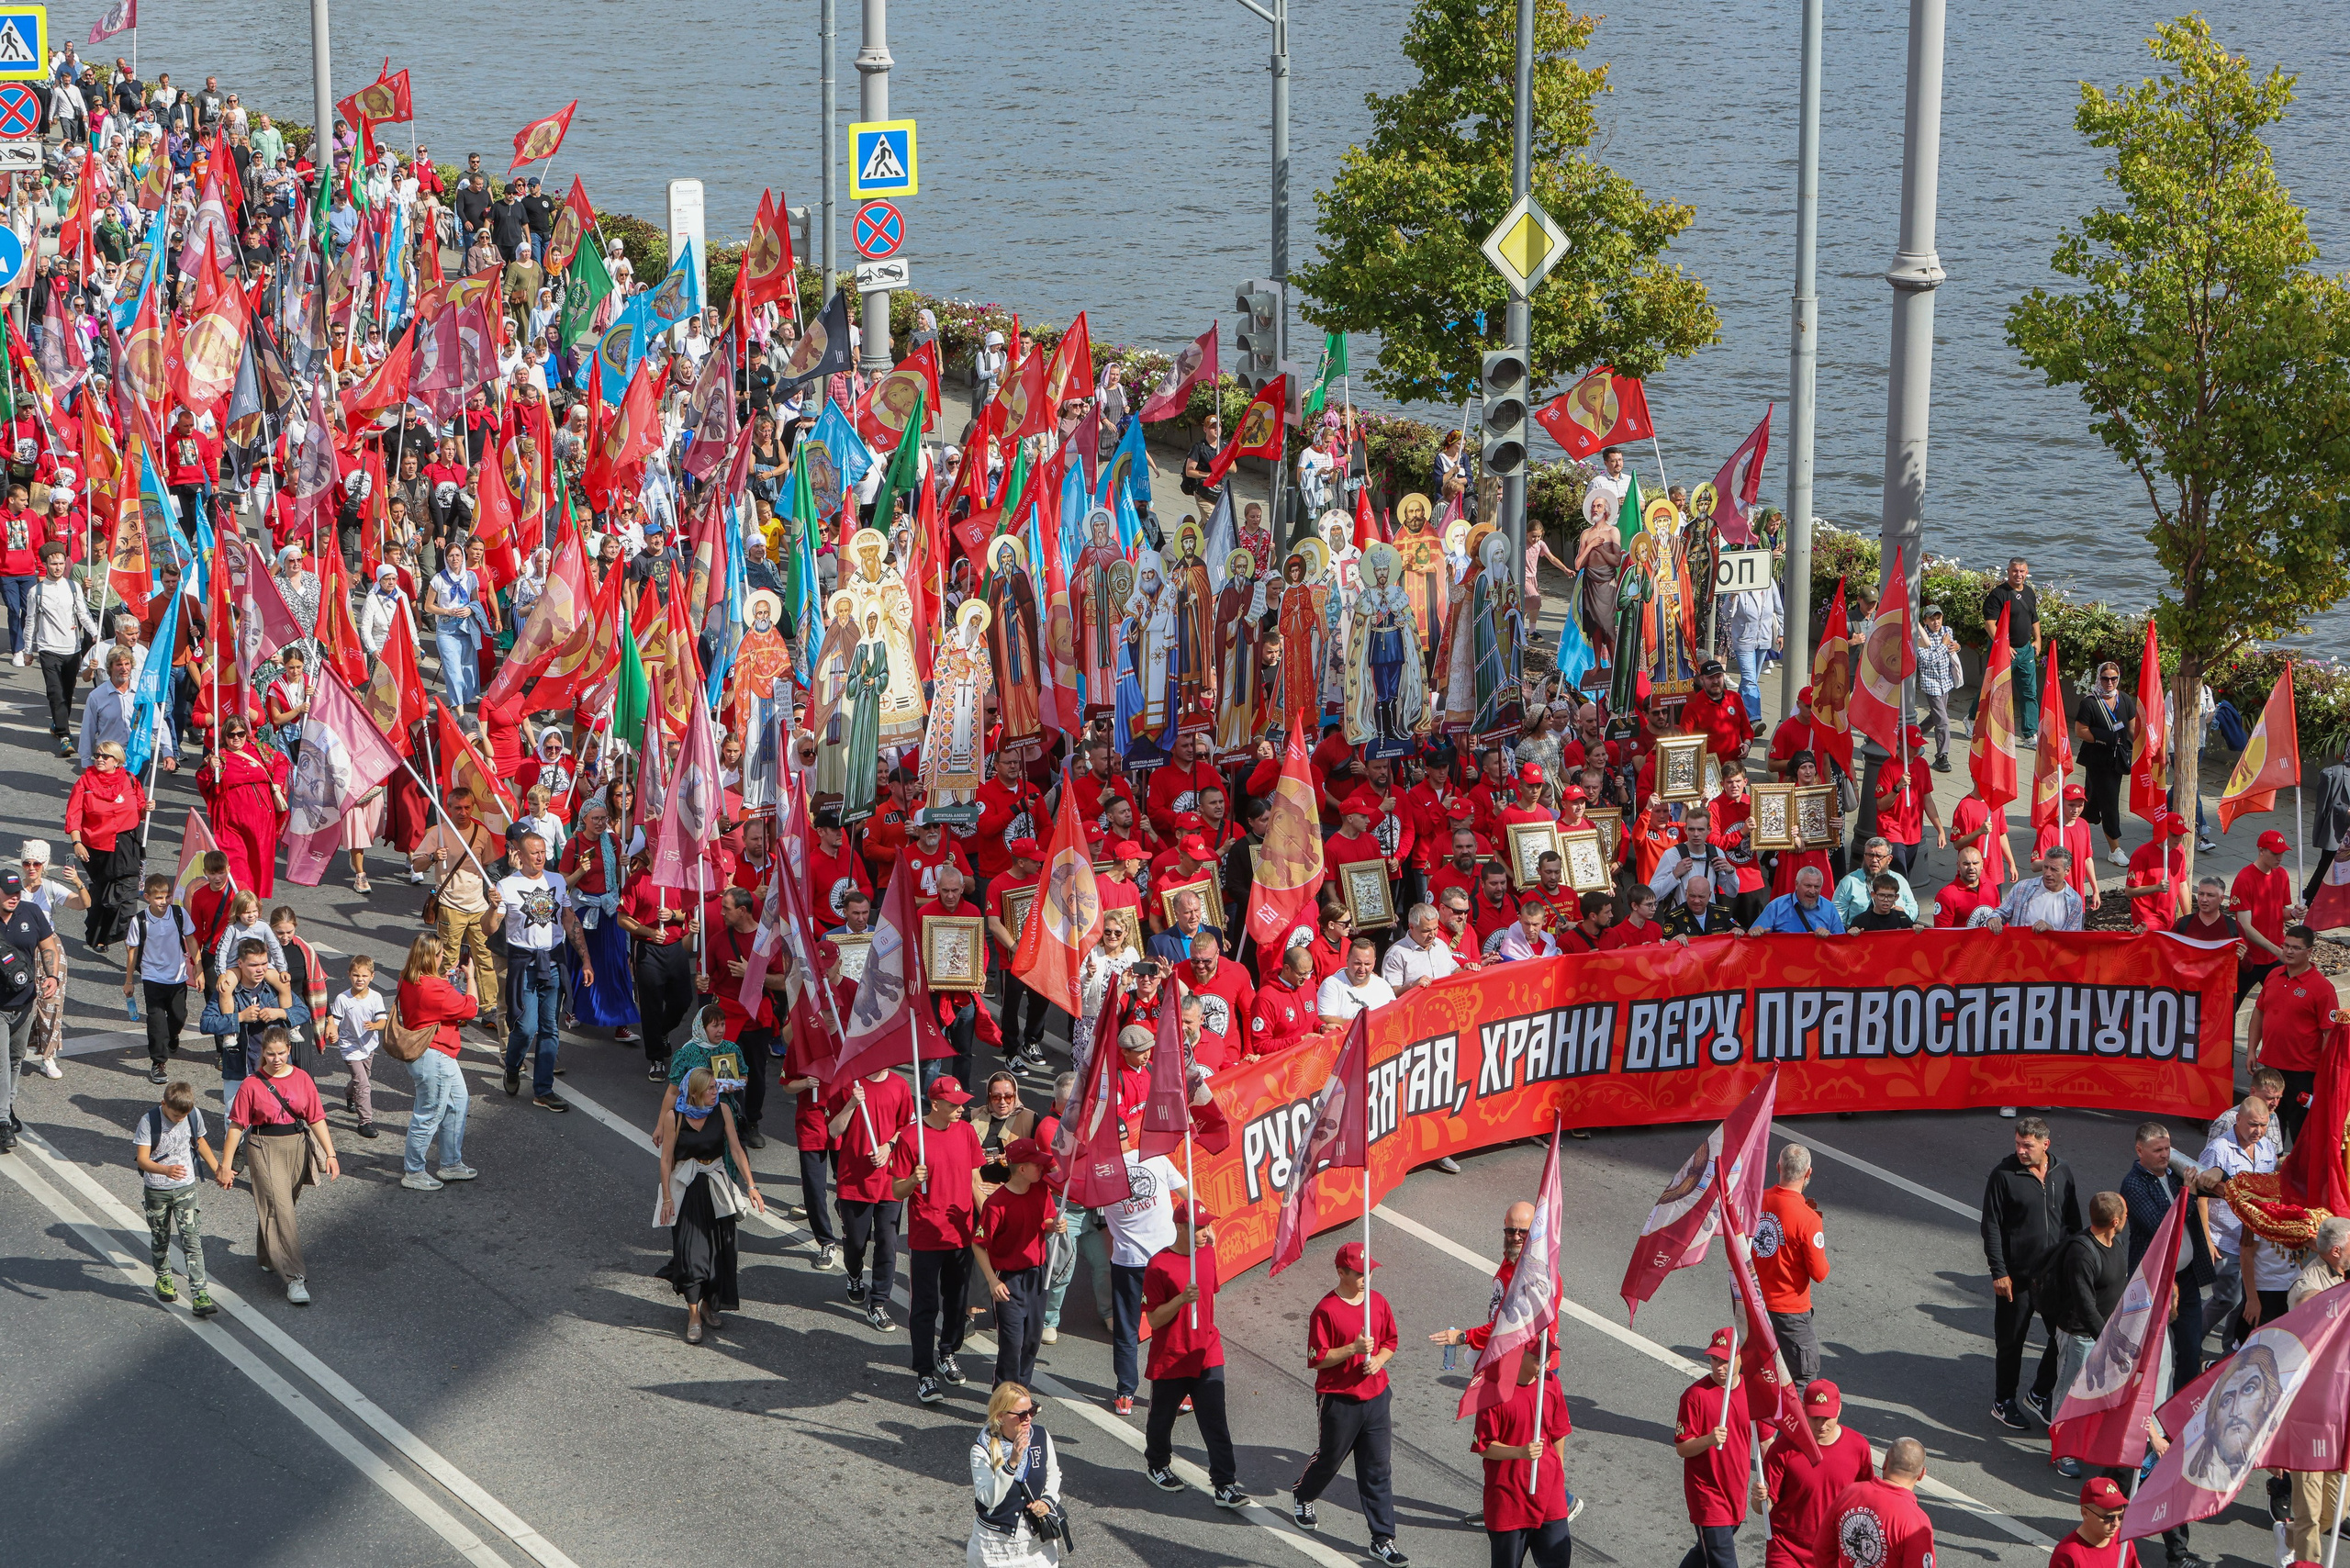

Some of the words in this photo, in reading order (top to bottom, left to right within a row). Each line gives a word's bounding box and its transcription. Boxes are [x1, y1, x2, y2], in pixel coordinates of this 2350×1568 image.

[884, 812, 900, 824] 40
[1242, 1092, 1331, 1203] РУС
[1368, 1034, 1468, 1144] ВЯТАЯ,
[1478, 1002, 1615, 1099] ХРАНИ
[1030, 1445, 1042, 1469] F
[1857, 1506, 1882, 1528] СОРОК
